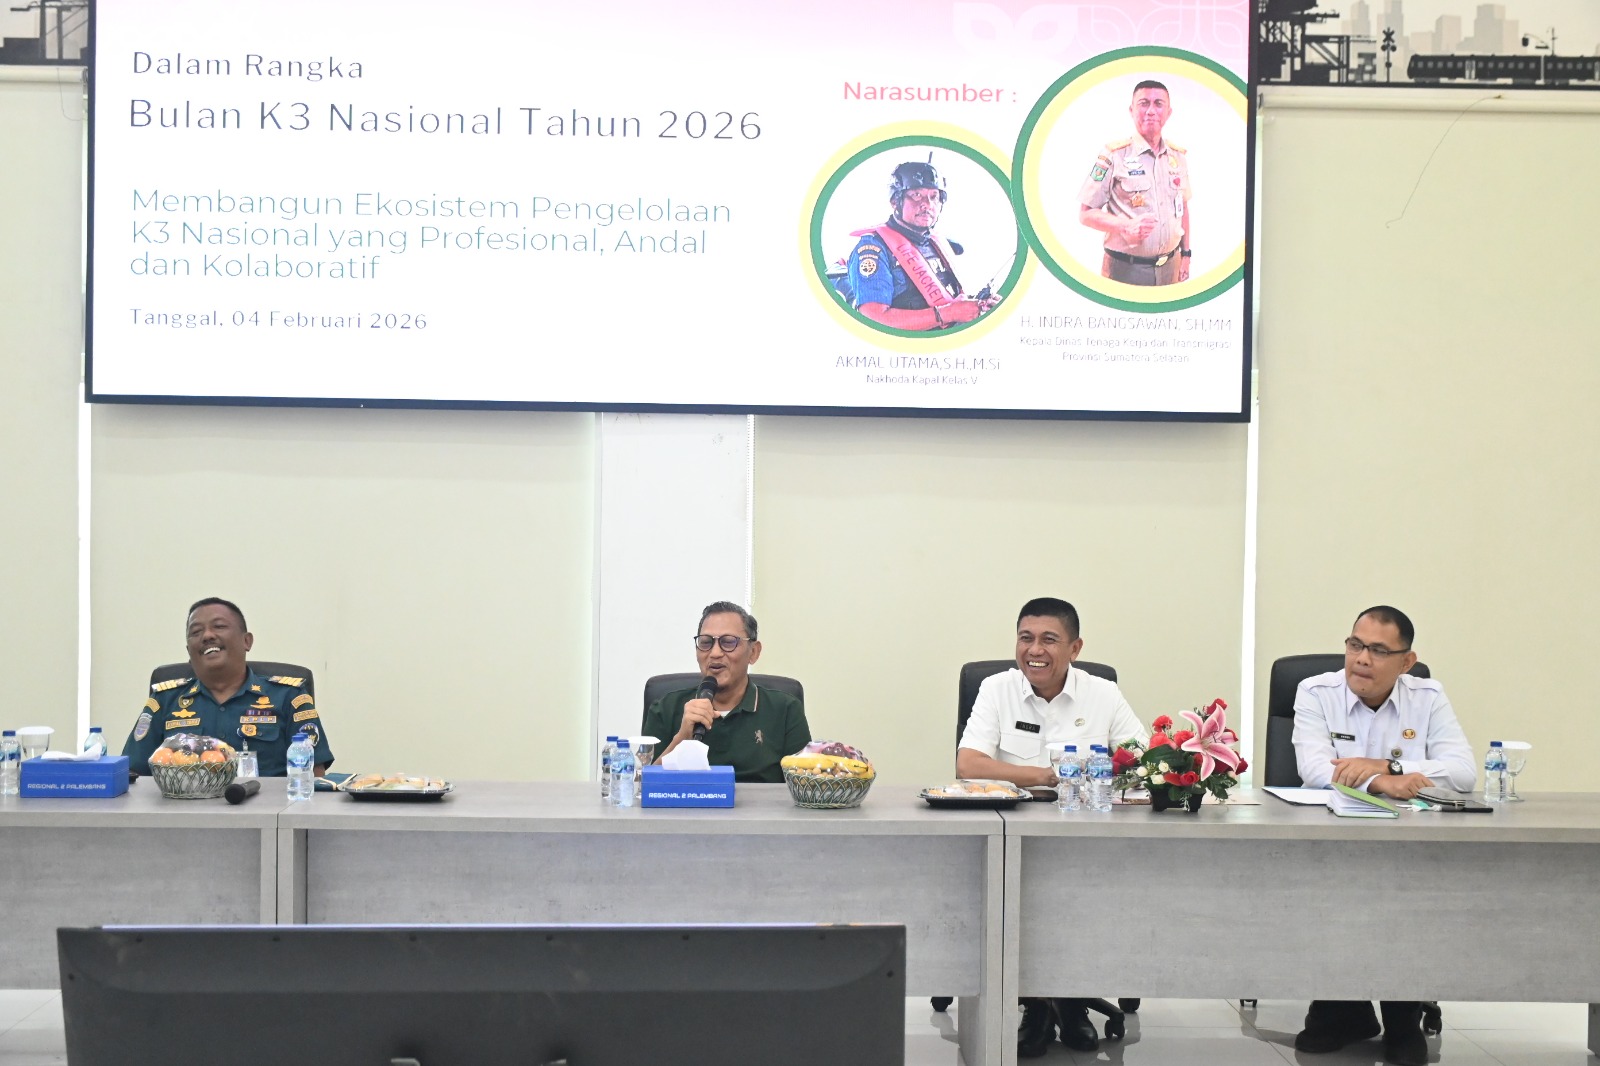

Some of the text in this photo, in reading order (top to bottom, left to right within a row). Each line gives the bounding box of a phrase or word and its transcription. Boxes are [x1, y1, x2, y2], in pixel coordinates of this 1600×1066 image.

[133, 51, 363, 82] Dalam Rangka
[844, 81, 1004, 103] Narasumber
[130, 99, 762, 140] Bulan K3 Nasional Tahun 2026
[133, 189, 731, 227] Membangun Ekosistem Pengelolaan
[133, 221, 706, 256] K3 Nasional yang Profesional, Andal
[130, 251, 381, 279] dan Kolaboratif
[896, 243, 920, 265] LIFE
[912, 265, 946, 304] JACKET
[232, 310, 260, 327] 04
[270, 311, 361, 328] Februari
[370, 312, 427, 329] 2026
[1020, 315, 1034, 329] H.
[1039, 316, 1083, 329] INDRA
[1020, 336, 1232, 351] Kepala Dinas Tenaga Kerja dan Transmigrasi
[835, 355, 885, 368] AKMAL
[1062, 351, 1189, 363] Provinsi Sumatera Selatan
[866, 374, 978, 386] Nakhoda Kapal Kelas V
